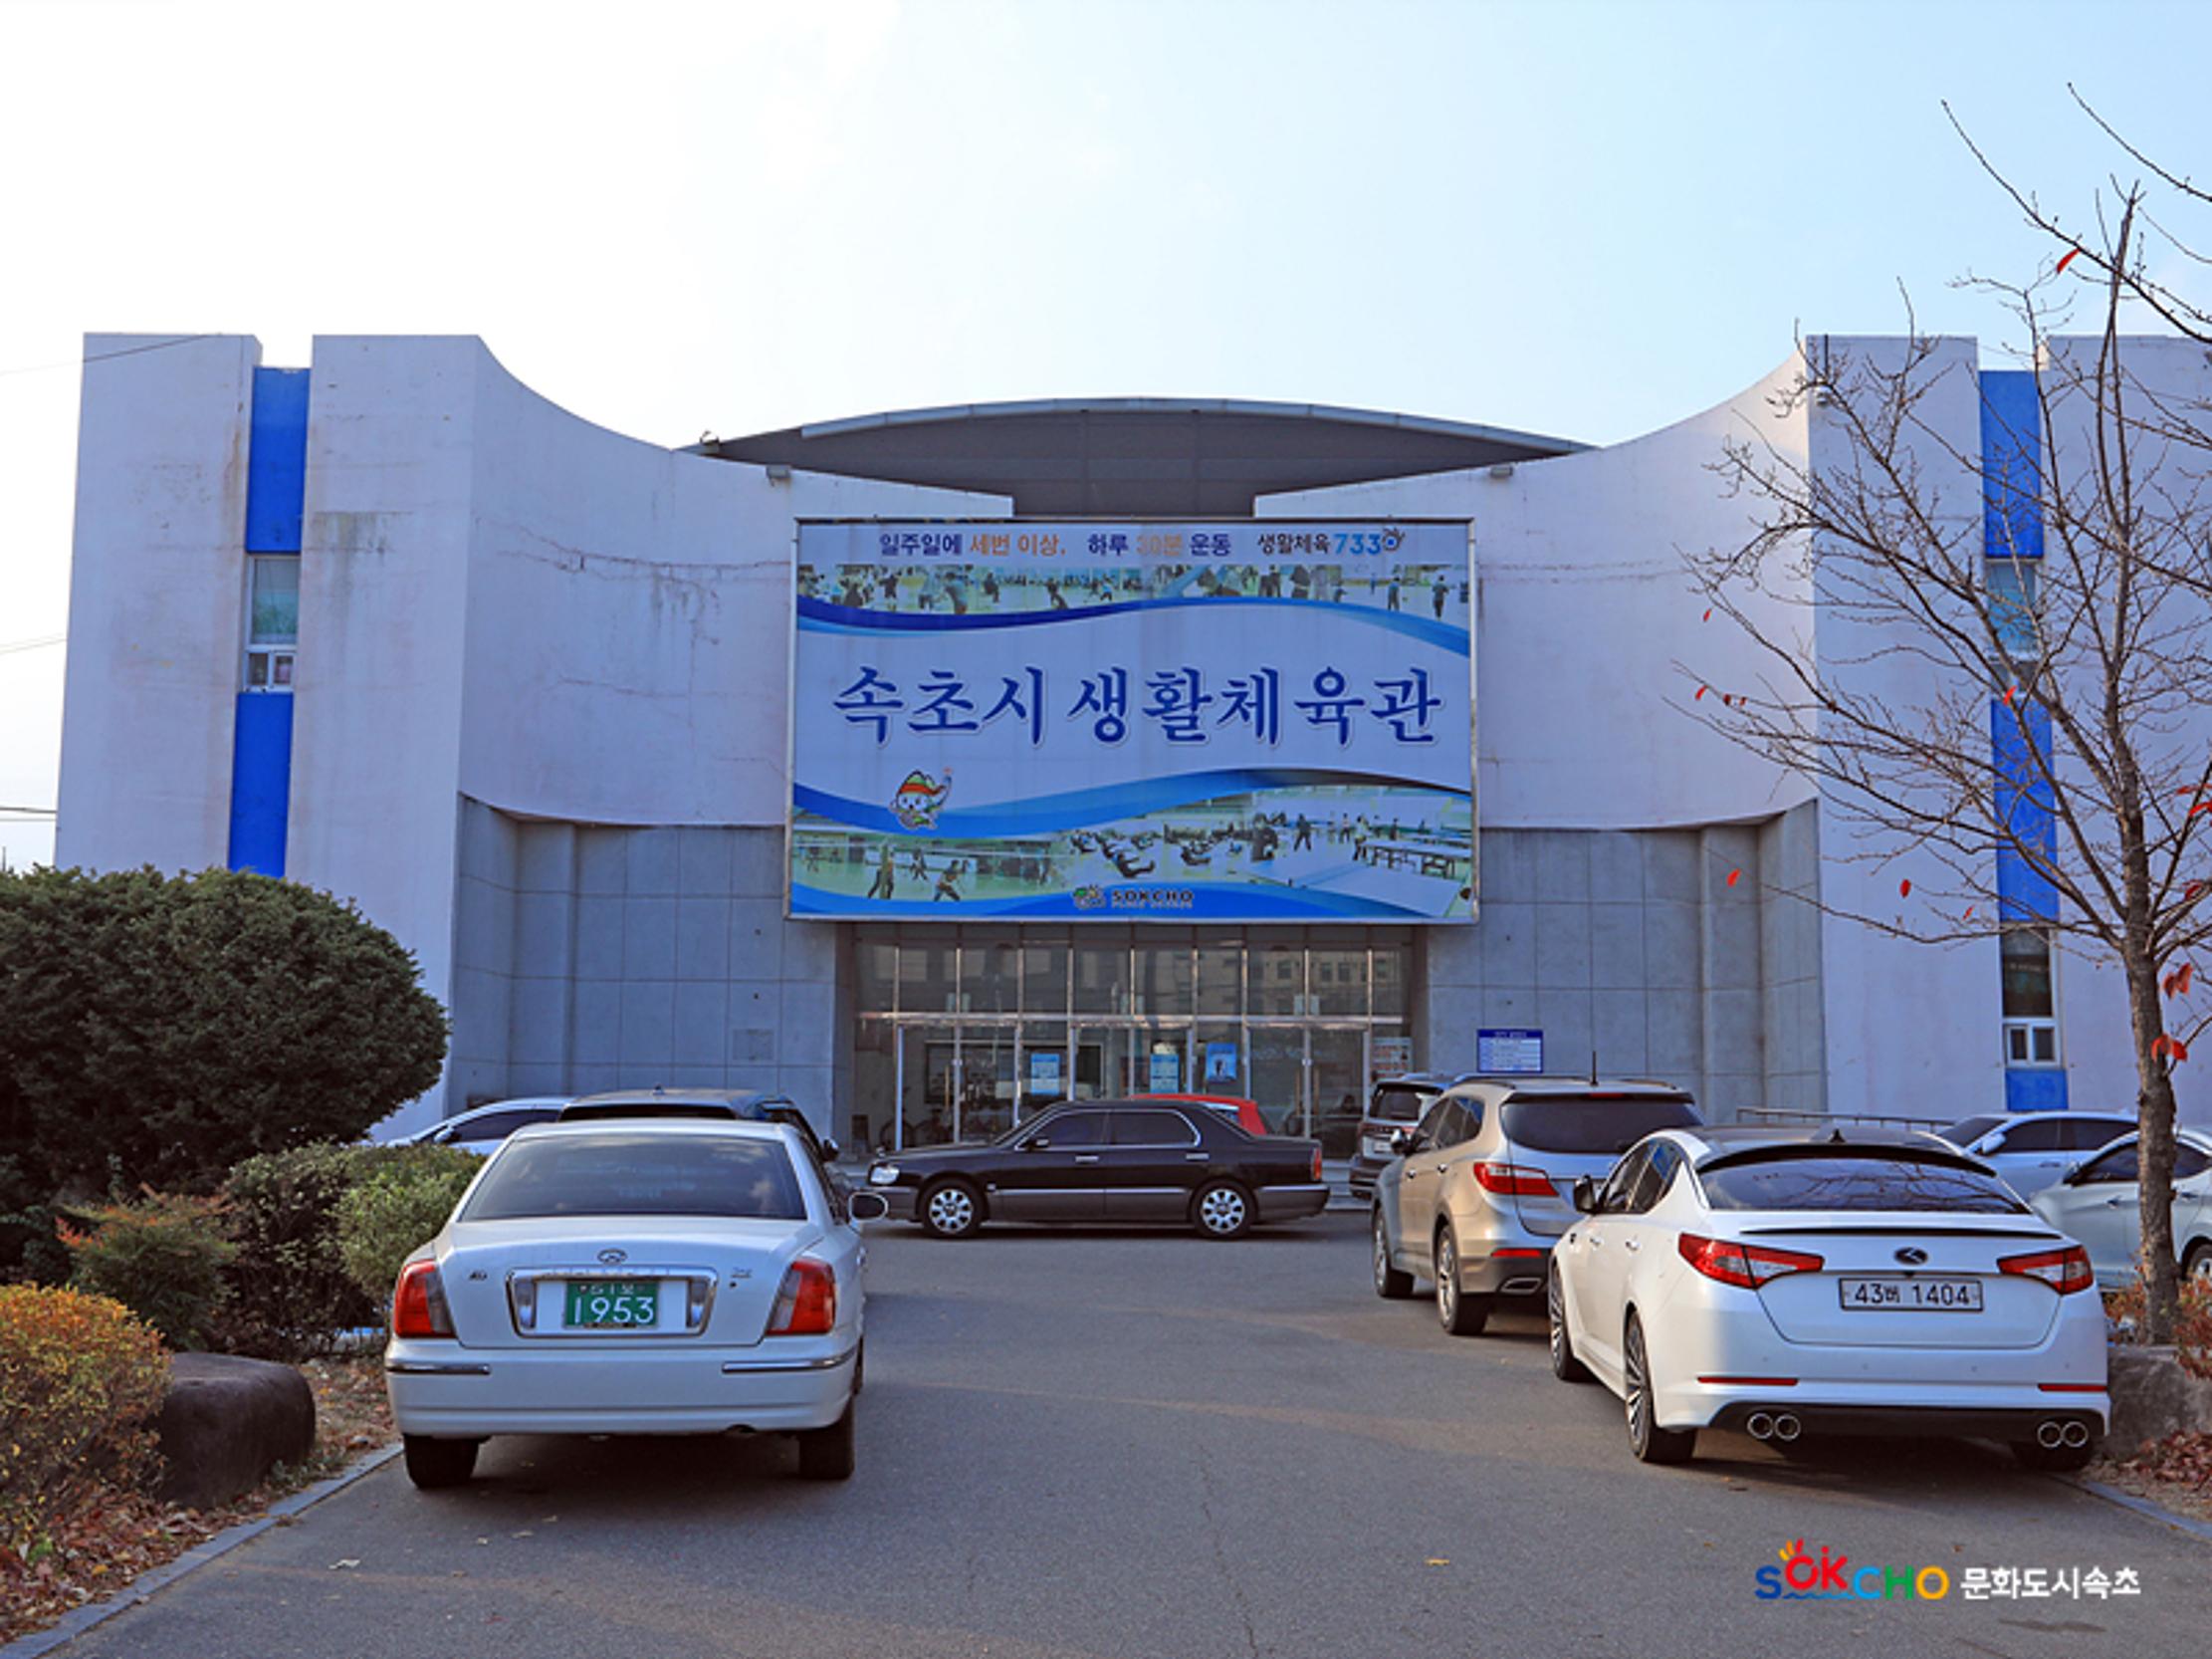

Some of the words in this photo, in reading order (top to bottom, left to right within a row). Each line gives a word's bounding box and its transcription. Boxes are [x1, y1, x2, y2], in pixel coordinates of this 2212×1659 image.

[879, 533, 963, 556] 일주일에
[970, 534, 1010, 556] 세번
[1087, 534, 1129, 556] 하루
[1136, 534, 1182, 556] 30분
[1189, 533, 1231, 557] 운동
[1257, 533, 1331, 556] 생활체육
[833, 666, 1043, 745] 속초시
[1067, 666, 1441, 745] 생활체육관
[1112, 889, 1194, 904] SOKCHO
[1912, 1283, 1970, 1305] 1404
[574, 1297, 654, 1323] 1953
